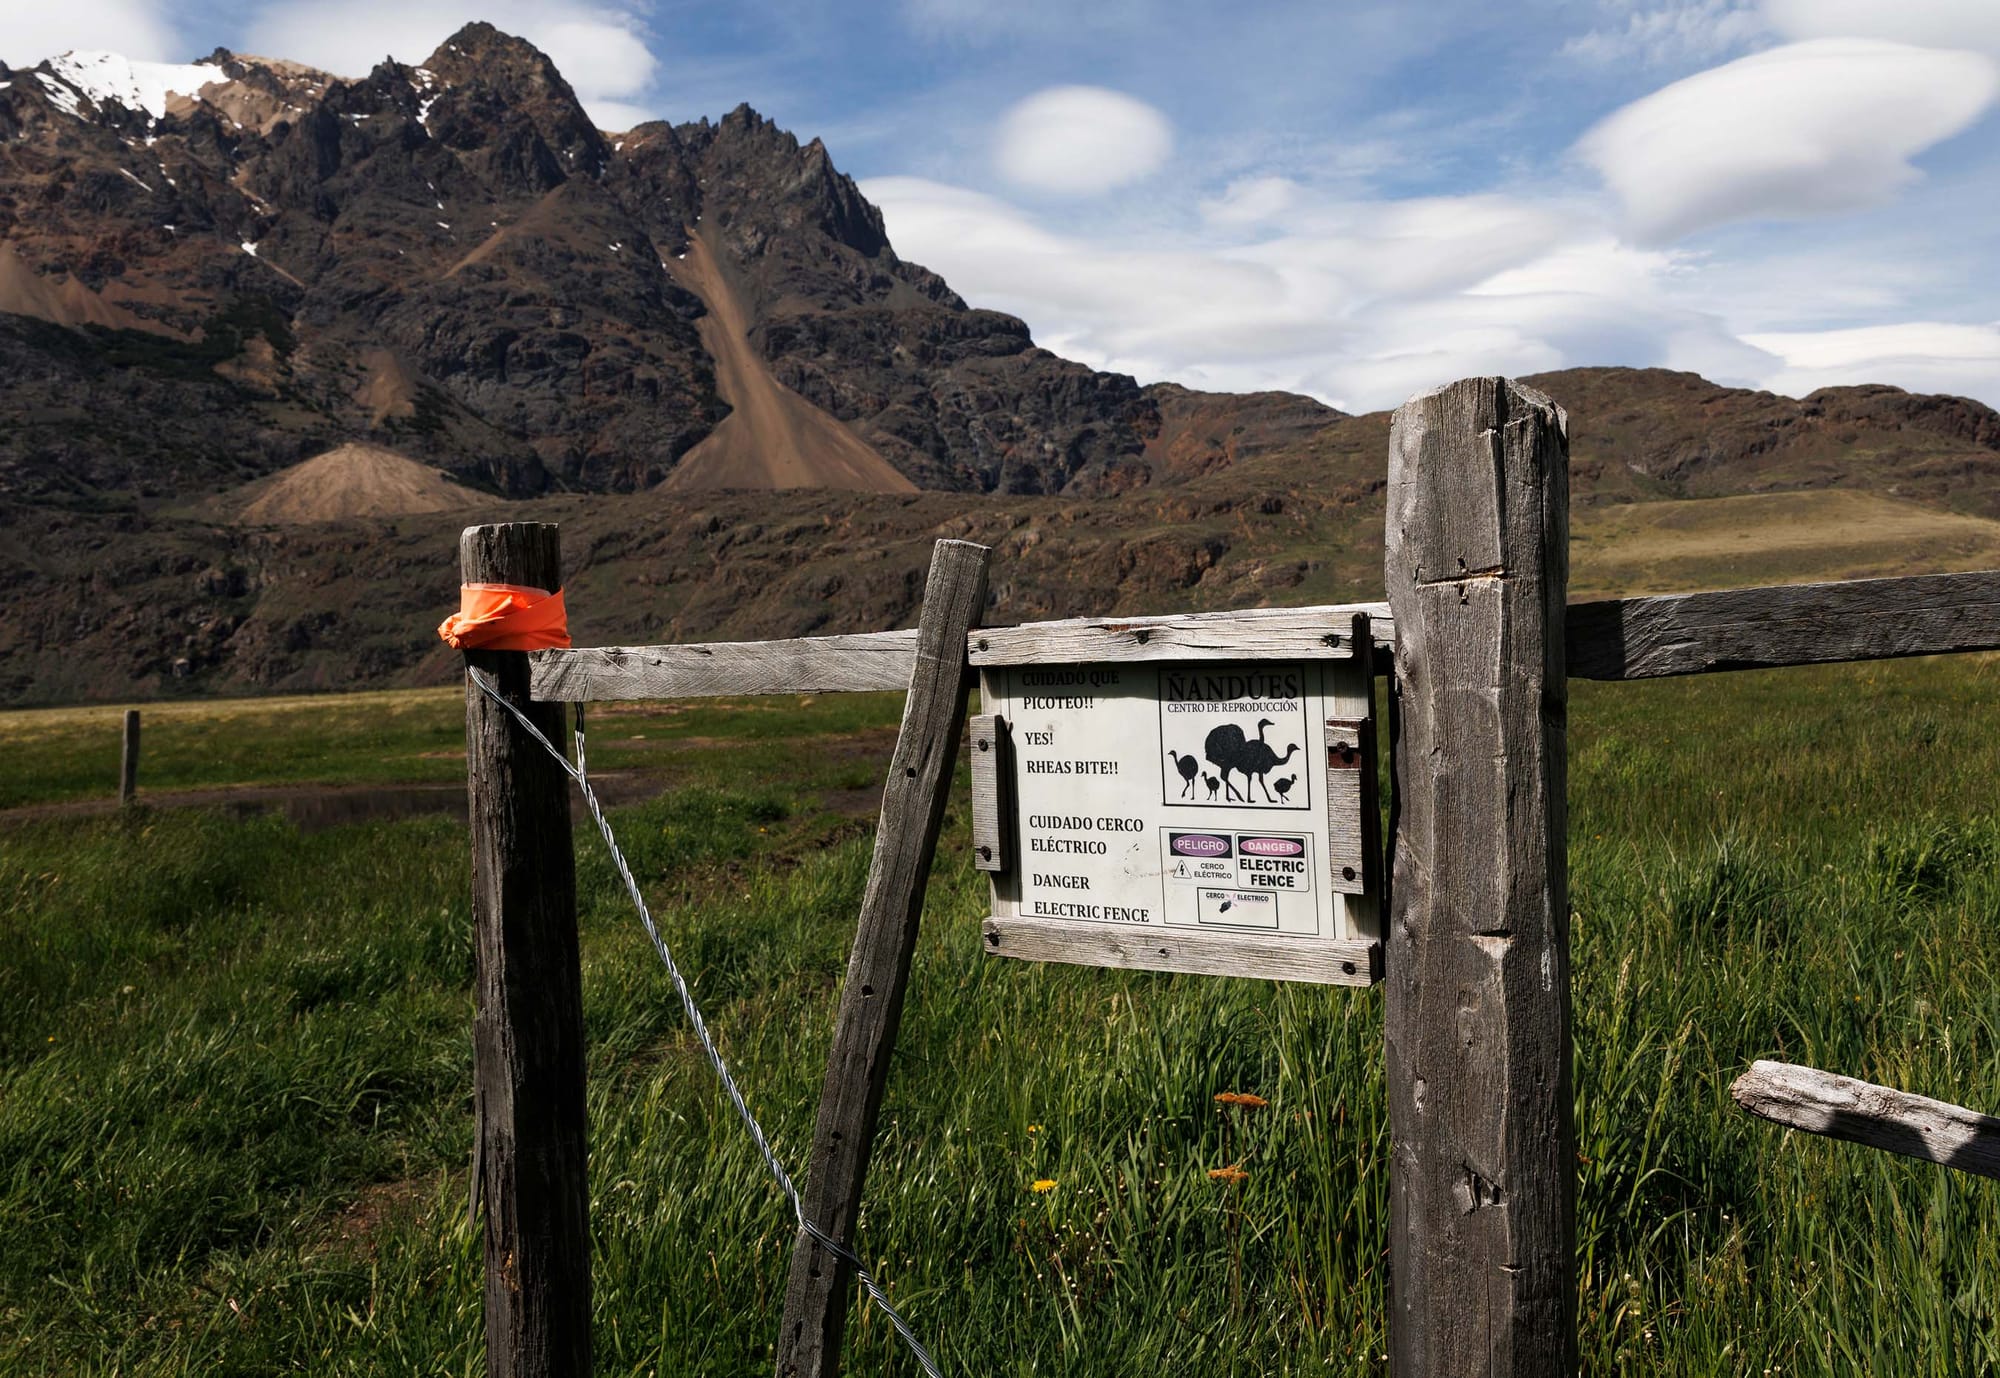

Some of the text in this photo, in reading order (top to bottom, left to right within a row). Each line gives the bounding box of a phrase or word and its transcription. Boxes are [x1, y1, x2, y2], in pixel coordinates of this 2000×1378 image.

[1022, 671, 1120, 687] CUIDADO QUE
[1167, 670, 1298, 701] ÑANDÚES
[1023, 696, 1094, 710] PICOTEO!!
[1167, 700, 1298, 713] CENTRO DE REPRODUCCIÓN
[1025, 732, 1054, 745] YES!
[1027, 760, 1118, 775] RHEAS BITE!!
[1029, 815, 1144, 832] CUIDADO CERCO
[1031, 836, 1107, 854] ELÉCTRICO
[1177, 839, 1224, 851] PELIGRO
[1248, 841, 1294, 852] DANGER
[1200, 862, 1225, 870] CERCO
[1239, 858, 1305, 873] ELECTRIC
[1032, 873, 1090, 890] DANGER
[1194, 870, 1232, 879] ELÉCTRICO
[1251, 874, 1295, 887] FENCE
[1206, 891, 1225, 899] CERCO
[1034, 901, 1150, 922] ELECTRIC FENCE
